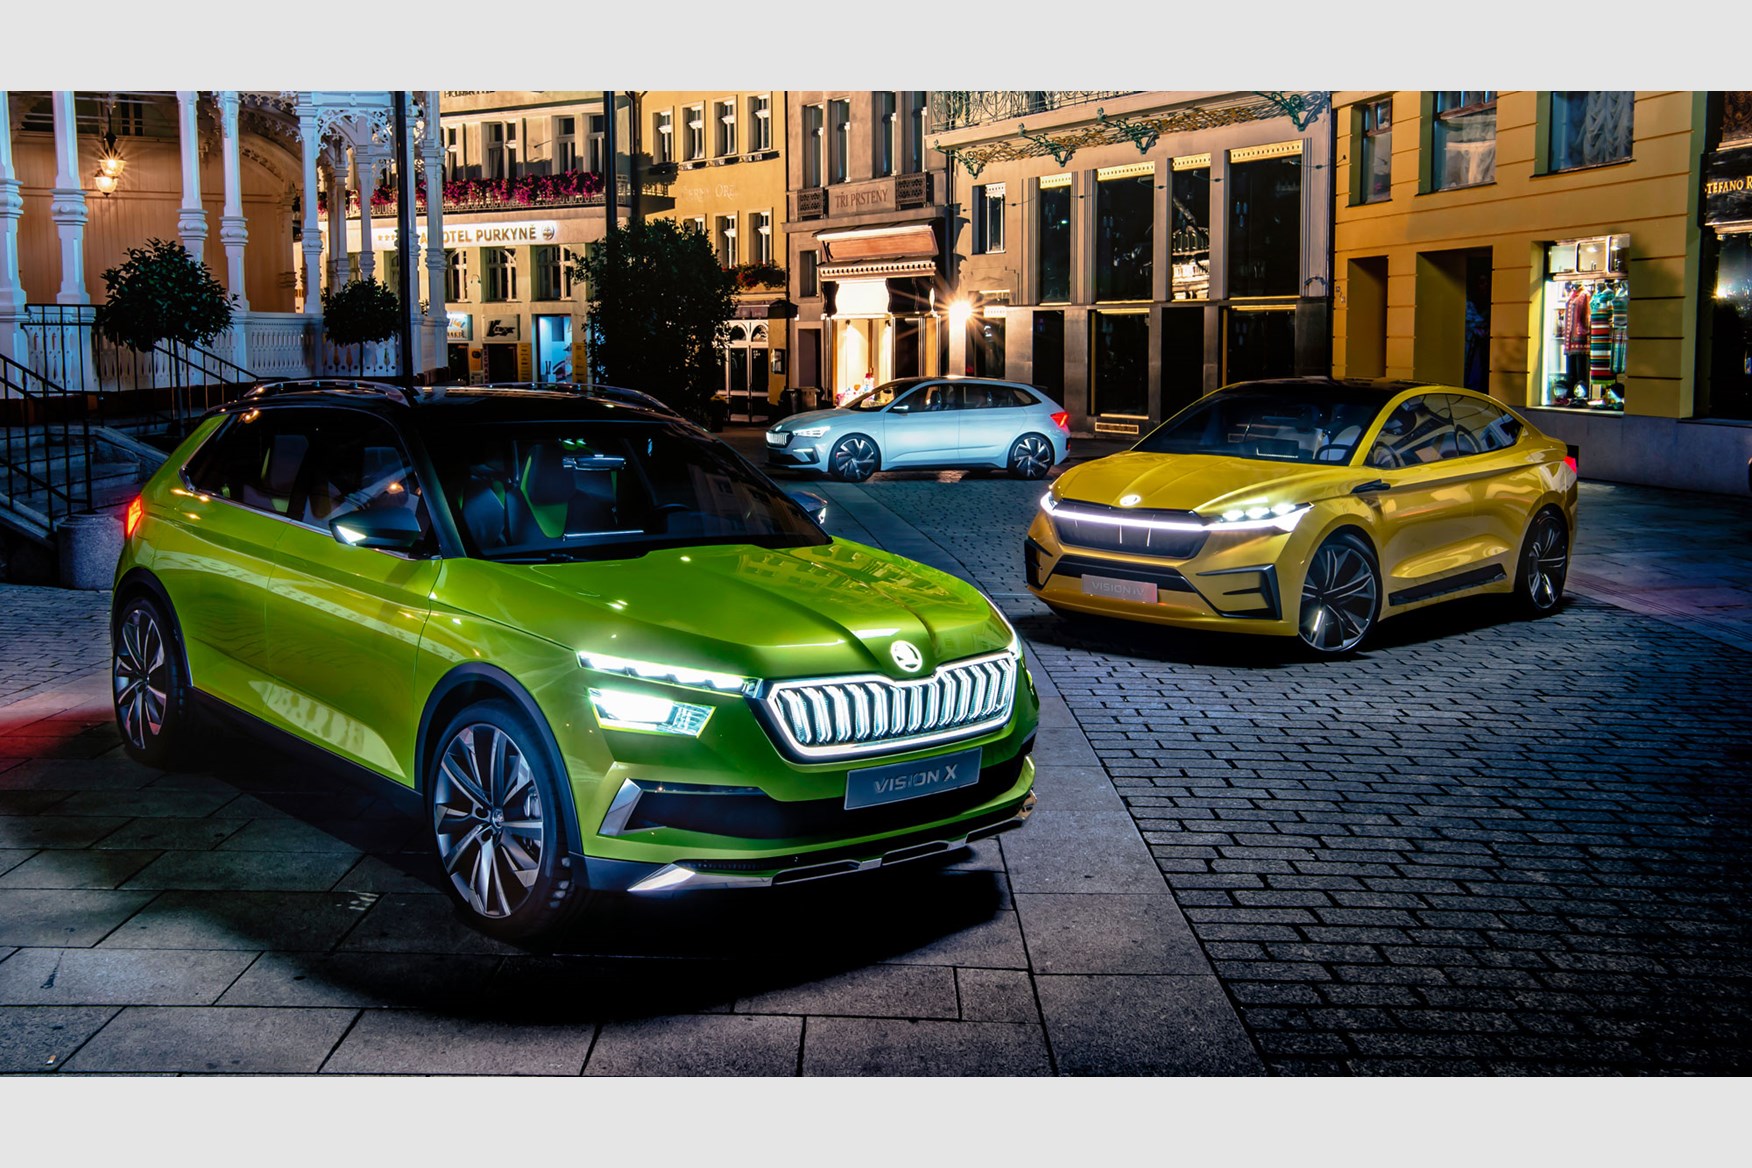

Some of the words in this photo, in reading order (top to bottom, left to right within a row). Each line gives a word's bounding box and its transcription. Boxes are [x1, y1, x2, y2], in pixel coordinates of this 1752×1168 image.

[1704, 180, 1744, 195] TEFANO
[834, 191, 849, 209] TŘI
[850, 188, 889, 207] PRSTENY
[443, 229, 473, 244] OTEL
[475, 224, 537, 242] PURKYNĚ
[1091, 581, 1132, 595] VISION
[873, 768, 940, 794] VISION
[943, 764, 959, 782] X
